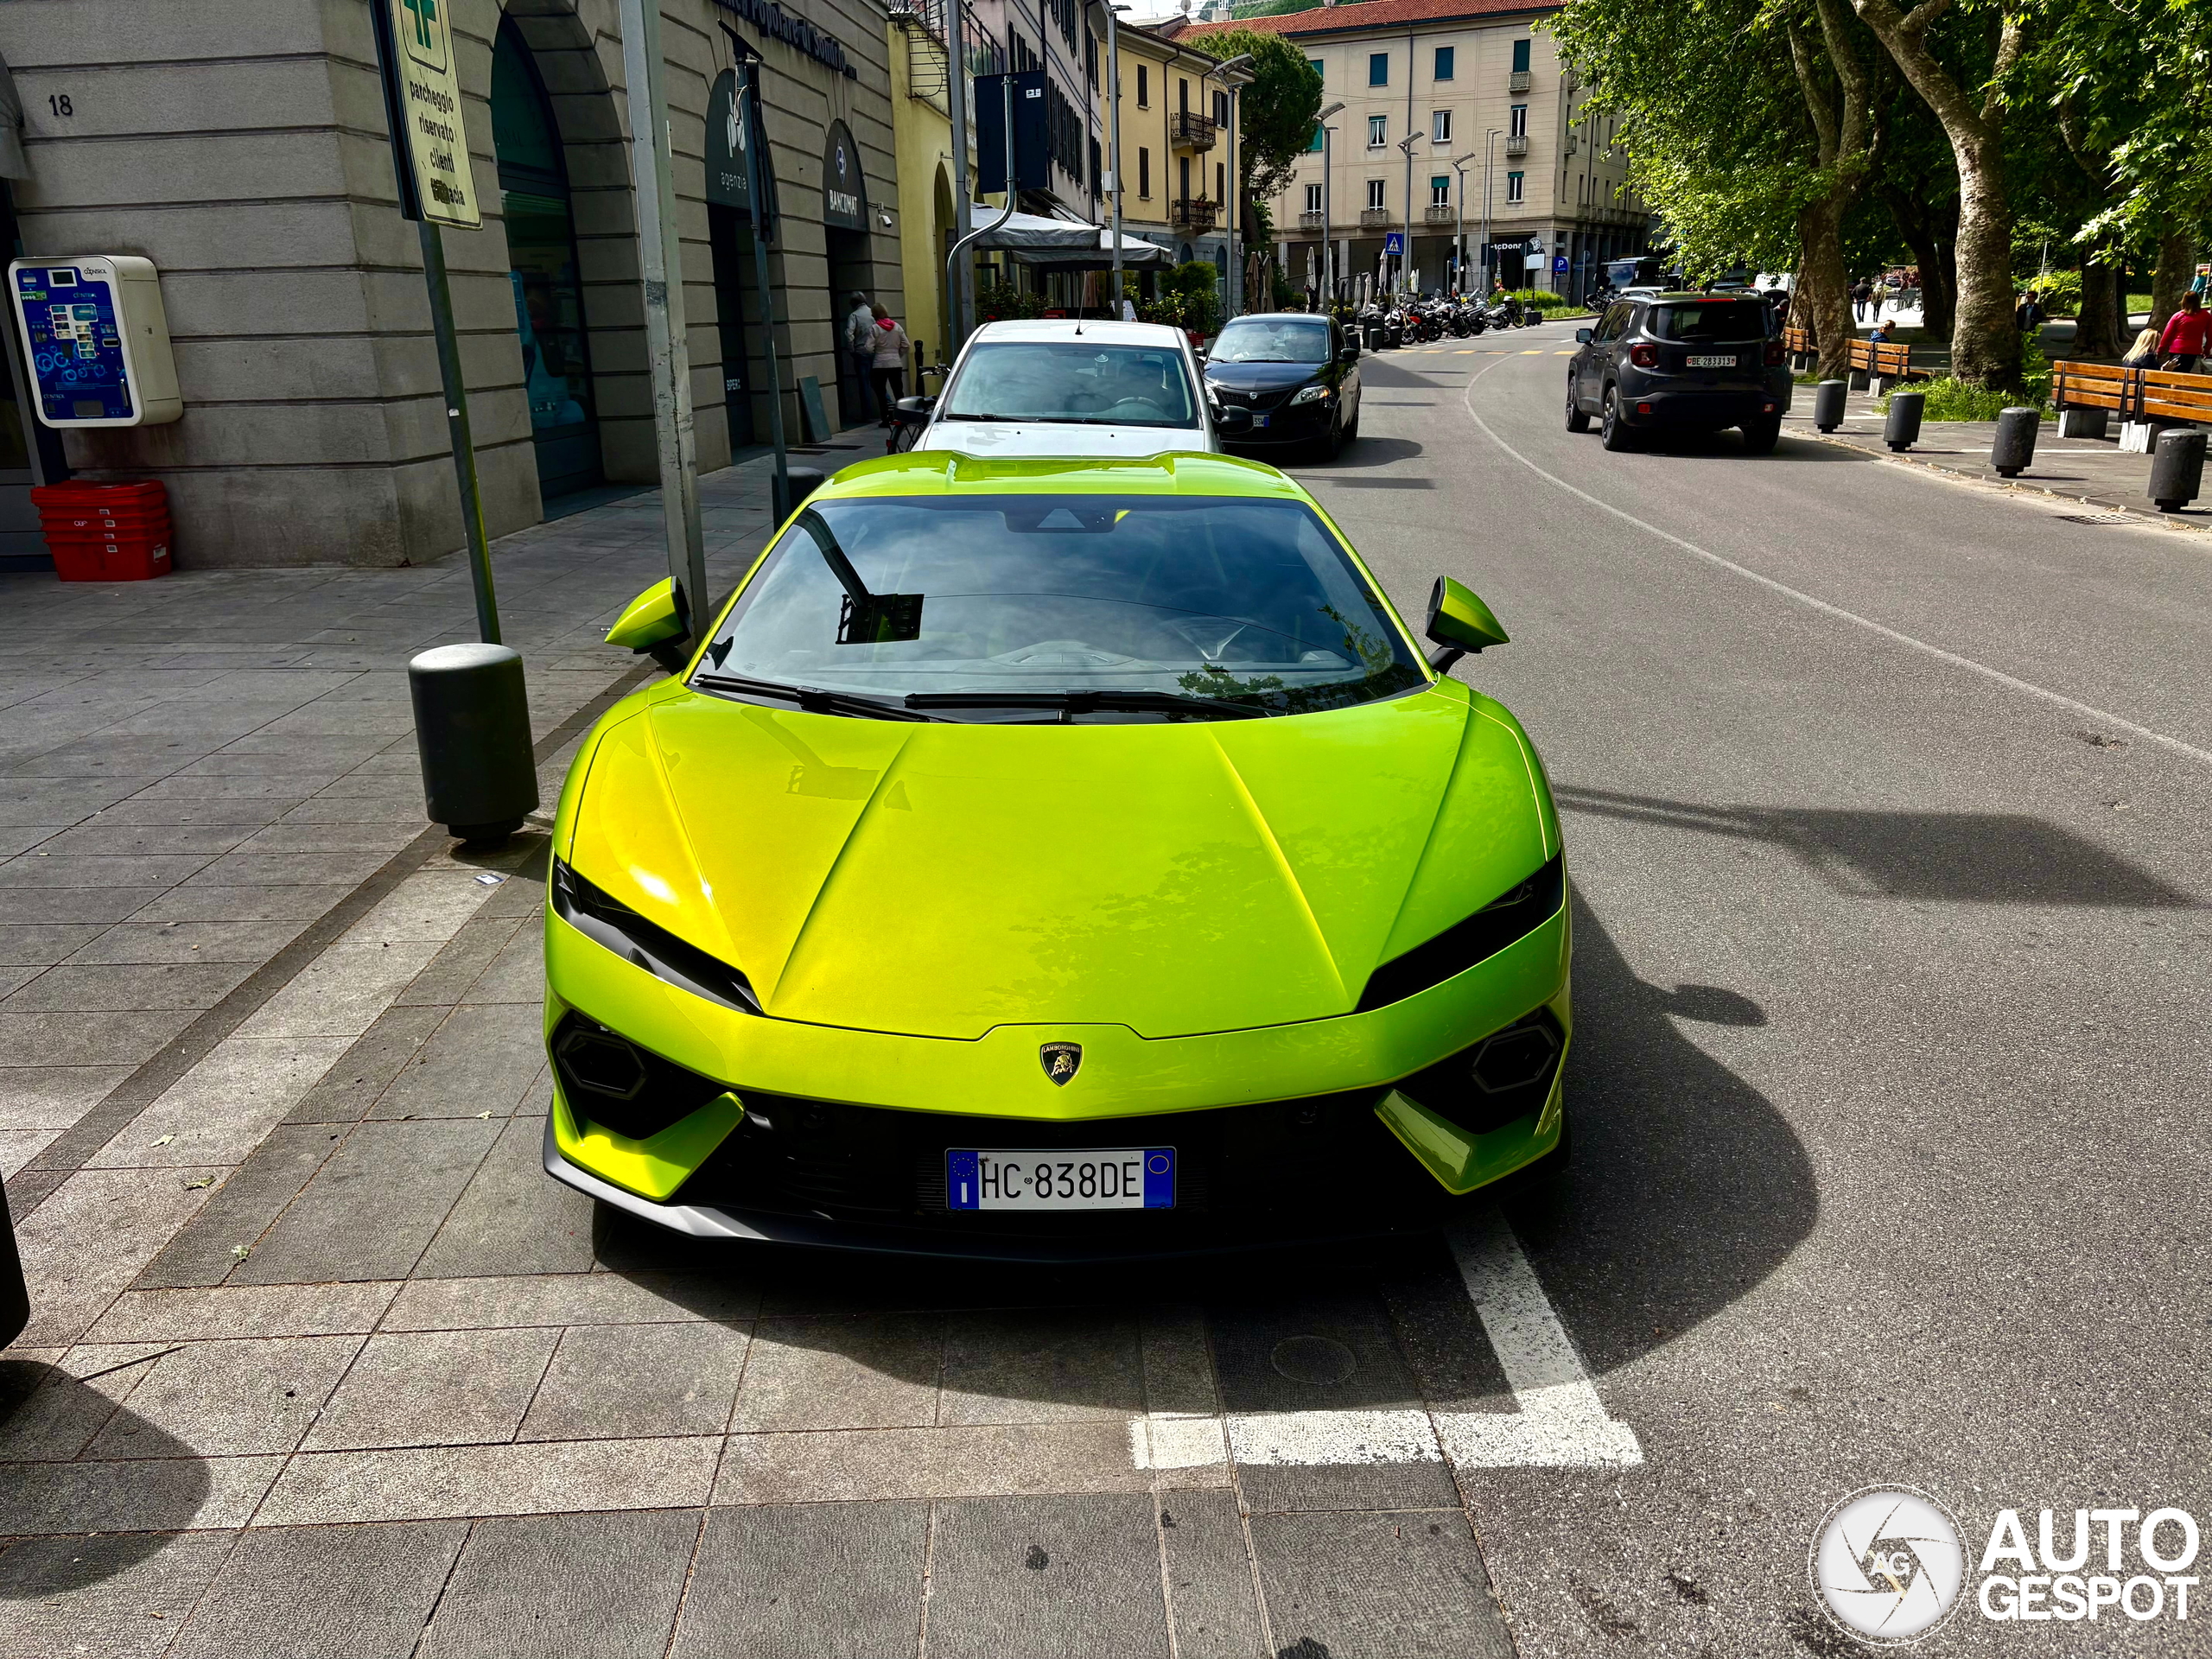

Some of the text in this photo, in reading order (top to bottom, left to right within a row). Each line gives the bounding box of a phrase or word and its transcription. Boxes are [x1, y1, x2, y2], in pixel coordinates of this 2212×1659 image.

[48, 94, 73, 116] 18
[410, 80, 454, 115] parcheggio
[418, 111, 454, 143] riservato
[430, 147, 455, 174] clienti
[721, 171, 747, 191] agenzia
[829, 189, 858, 216] BANCOMAT
[1043, 1045, 1080, 1053] LAMBORGHINI
[981, 1161, 1141, 1199] HC 838DE
